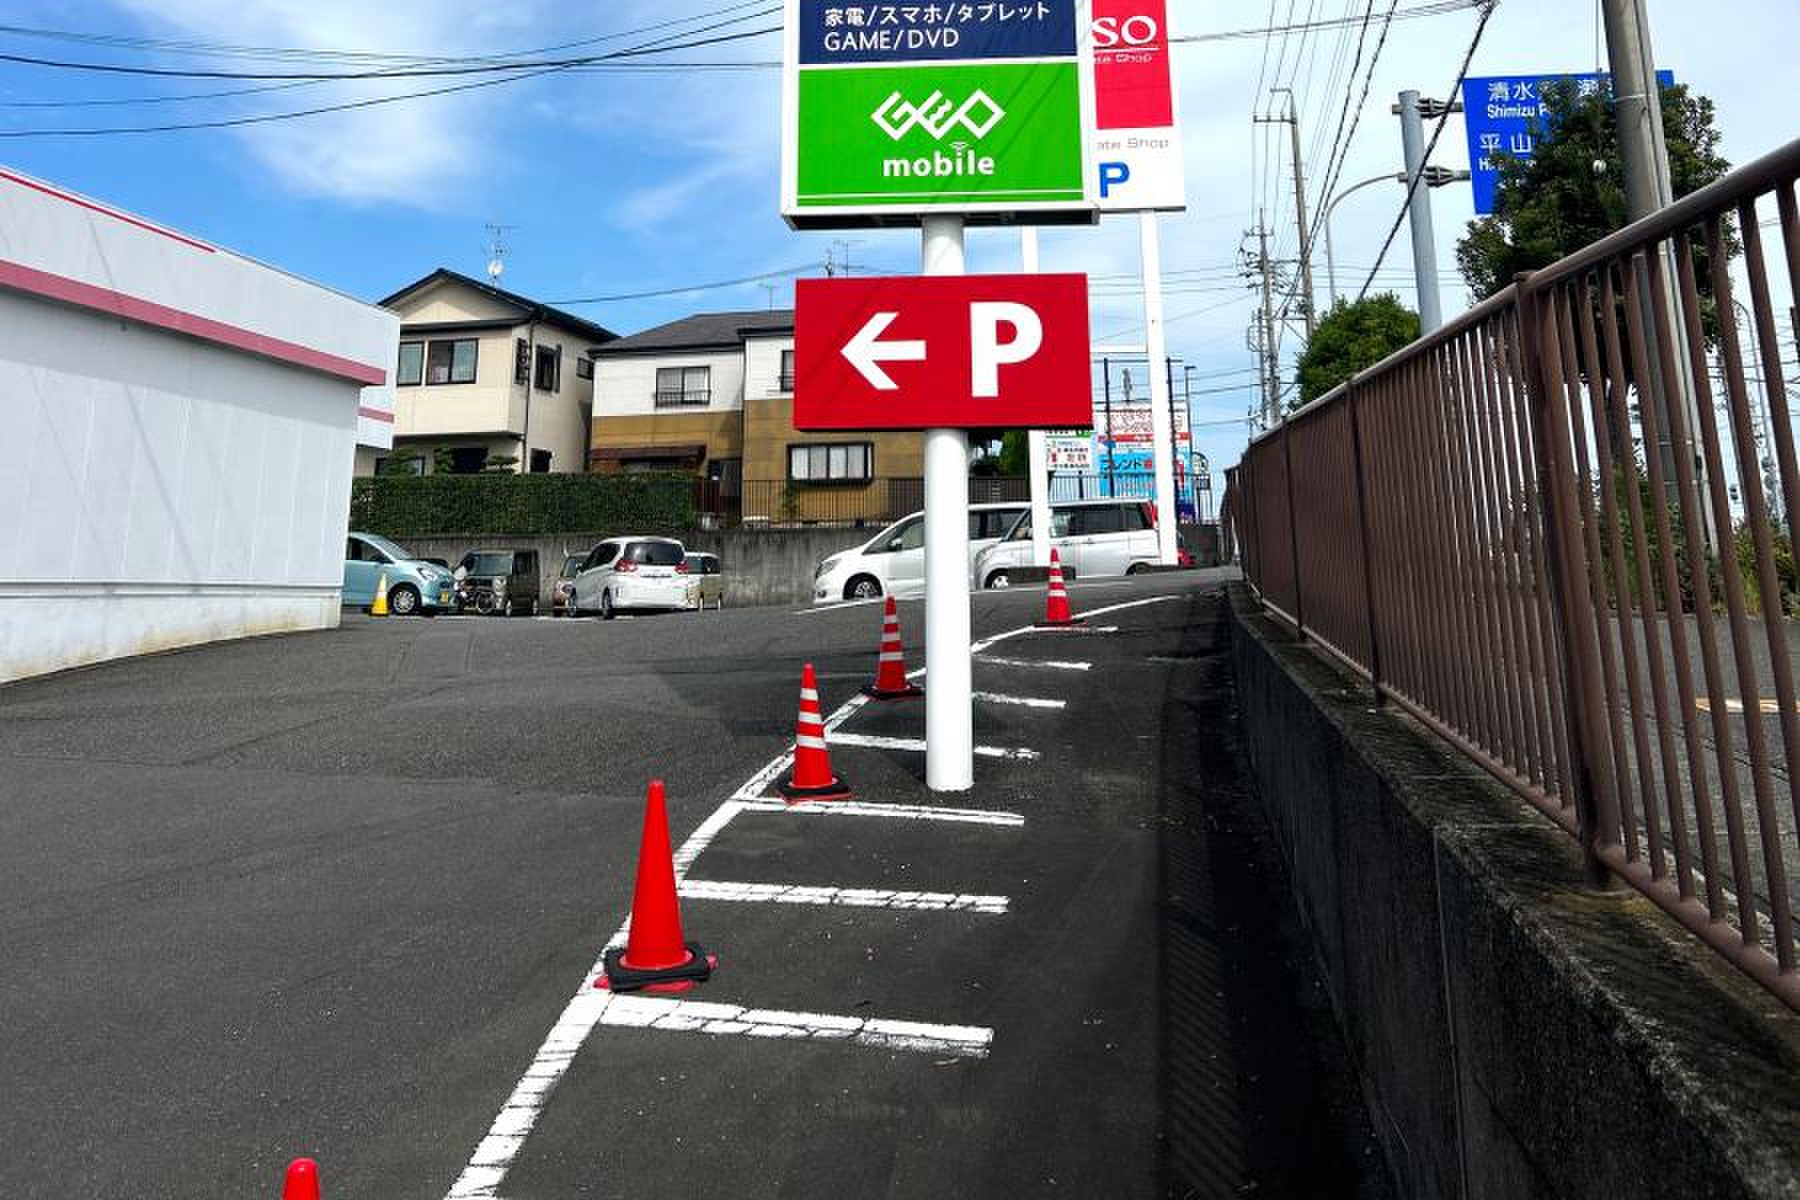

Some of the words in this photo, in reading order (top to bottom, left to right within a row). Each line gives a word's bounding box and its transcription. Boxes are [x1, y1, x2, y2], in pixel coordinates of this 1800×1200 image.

[824, 1, 1051, 28] 家電/スマホ/タブレット
[824, 28, 960, 52] GAME/DVD
[871, 88, 1007, 142] GEO
[1487, 104, 1536, 119] Shimizu
[883, 147, 996, 177] mobile
[1099, 161, 1131, 198] P
[970, 301, 1043, 397] P
